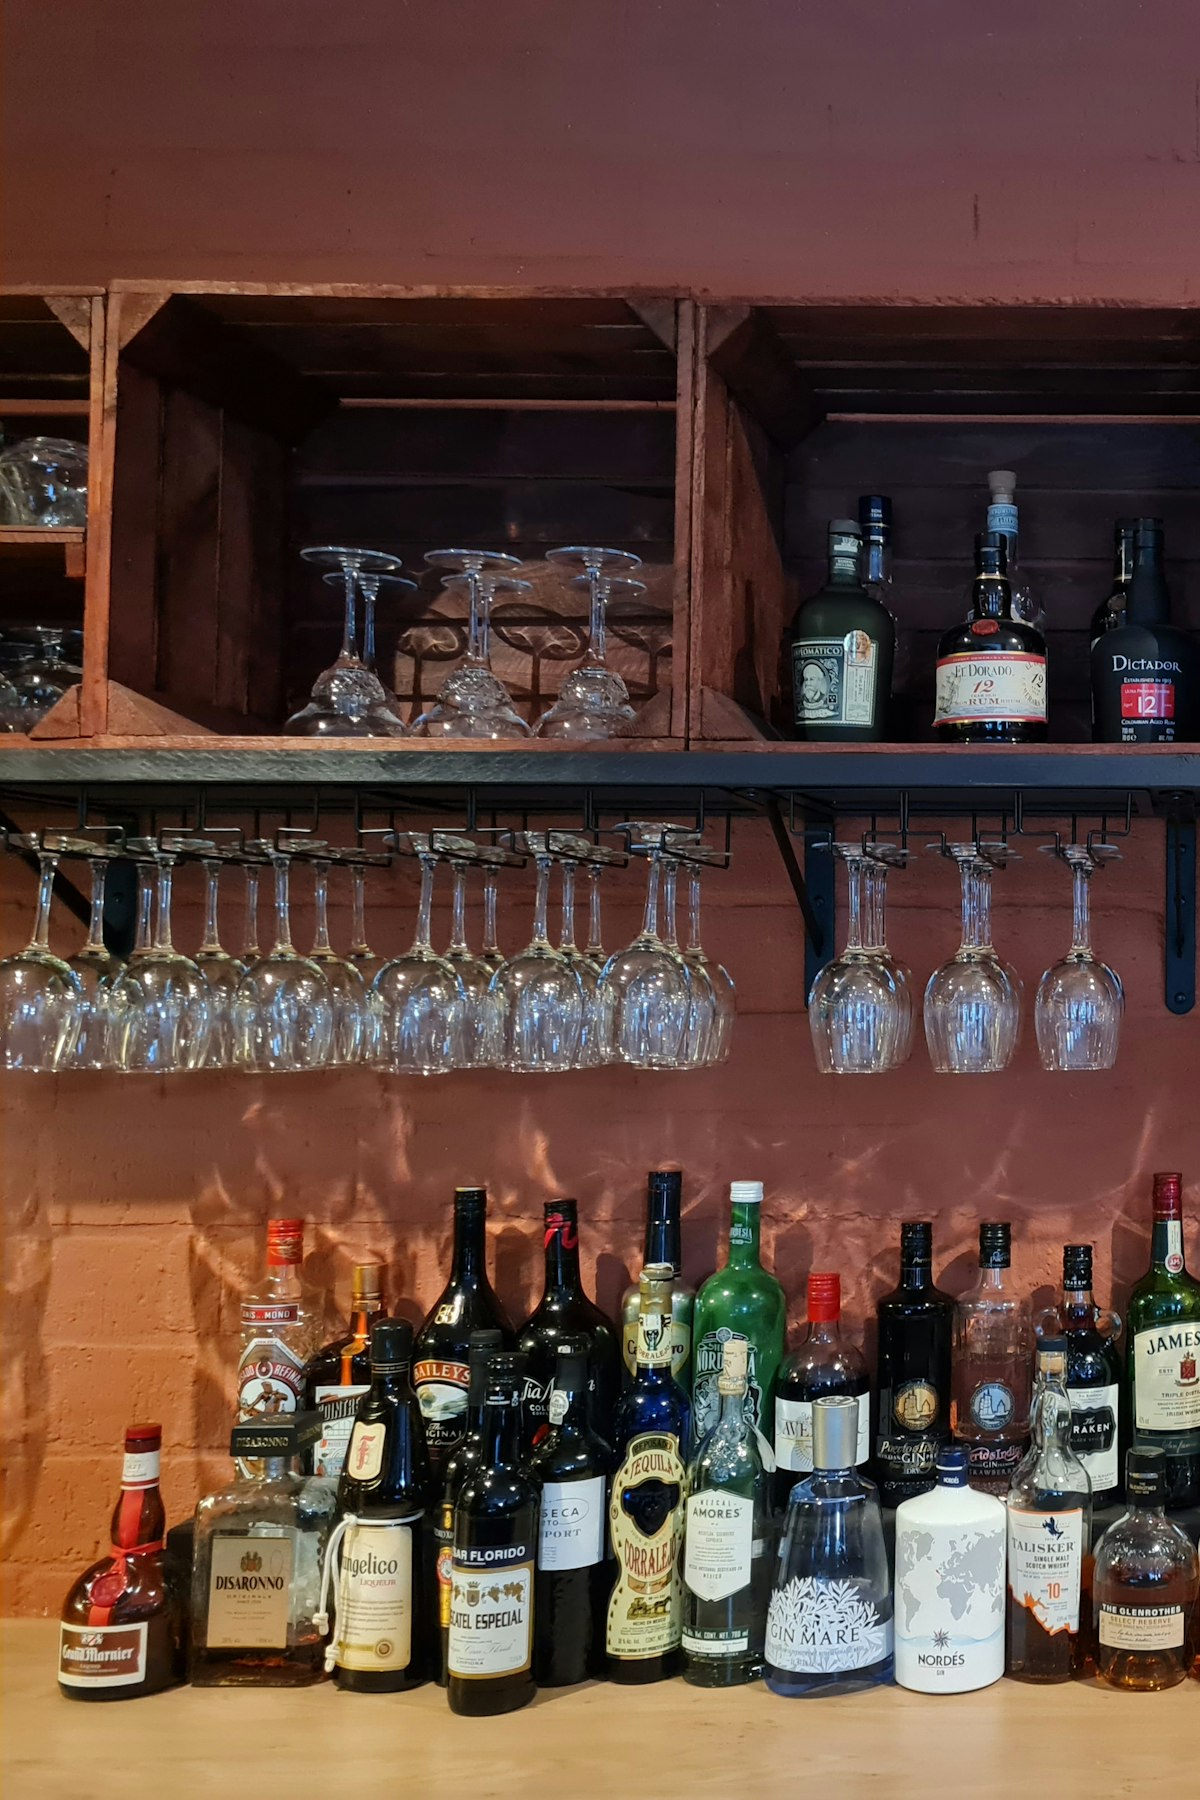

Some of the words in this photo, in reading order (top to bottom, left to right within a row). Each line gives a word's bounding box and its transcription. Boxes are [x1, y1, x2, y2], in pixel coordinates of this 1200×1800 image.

[969, 664, 1012, 678] DORADO
[973, 680, 994, 693] 12
[1032, 673, 1044, 688] 12
[1138, 696, 1157, 713] 12
[414, 1362, 471, 1382] BAILEYS
[523, 1377, 541, 1401] Tia
[1073, 1423, 1110, 1434] RAKEN
[236, 1437, 289, 1448] DISARONNO
[902, 1454, 925, 1464] GIN
[630, 1454, 674, 1480] TEQUILA
[542, 1508, 579, 1518] SECA
[693, 1507, 740, 1519] AMORES
[545, 1529, 582, 1538] PORT
[1012, 1537, 1074, 1553] TALISKER
[470, 1545, 526, 1562] FLORIDO
[624, 1533, 677, 1579] CORRALEJO
[1056, 1554, 1070, 1562] MALT
[216, 1576, 284, 1591] DISARONNO
[360, 1579, 396, 1588] LIQUEUR
[1047, 1582, 1060, 1599] 10
[1102, 1603, 1117, 1613] THE
[1120, 1605, 1181, 1616] GLENROTHES
[475, 1608, 523, 1630] ESPECIAL
[1110, 1616, 1136, 1624] SELECT
[770, 1623, 795, 1643] GIN
[801, 1627, 860, 1646] MARE
[85, 1647, 135, 1662] Marnier
[918, 1652, 965, 1667] NORDÉS
